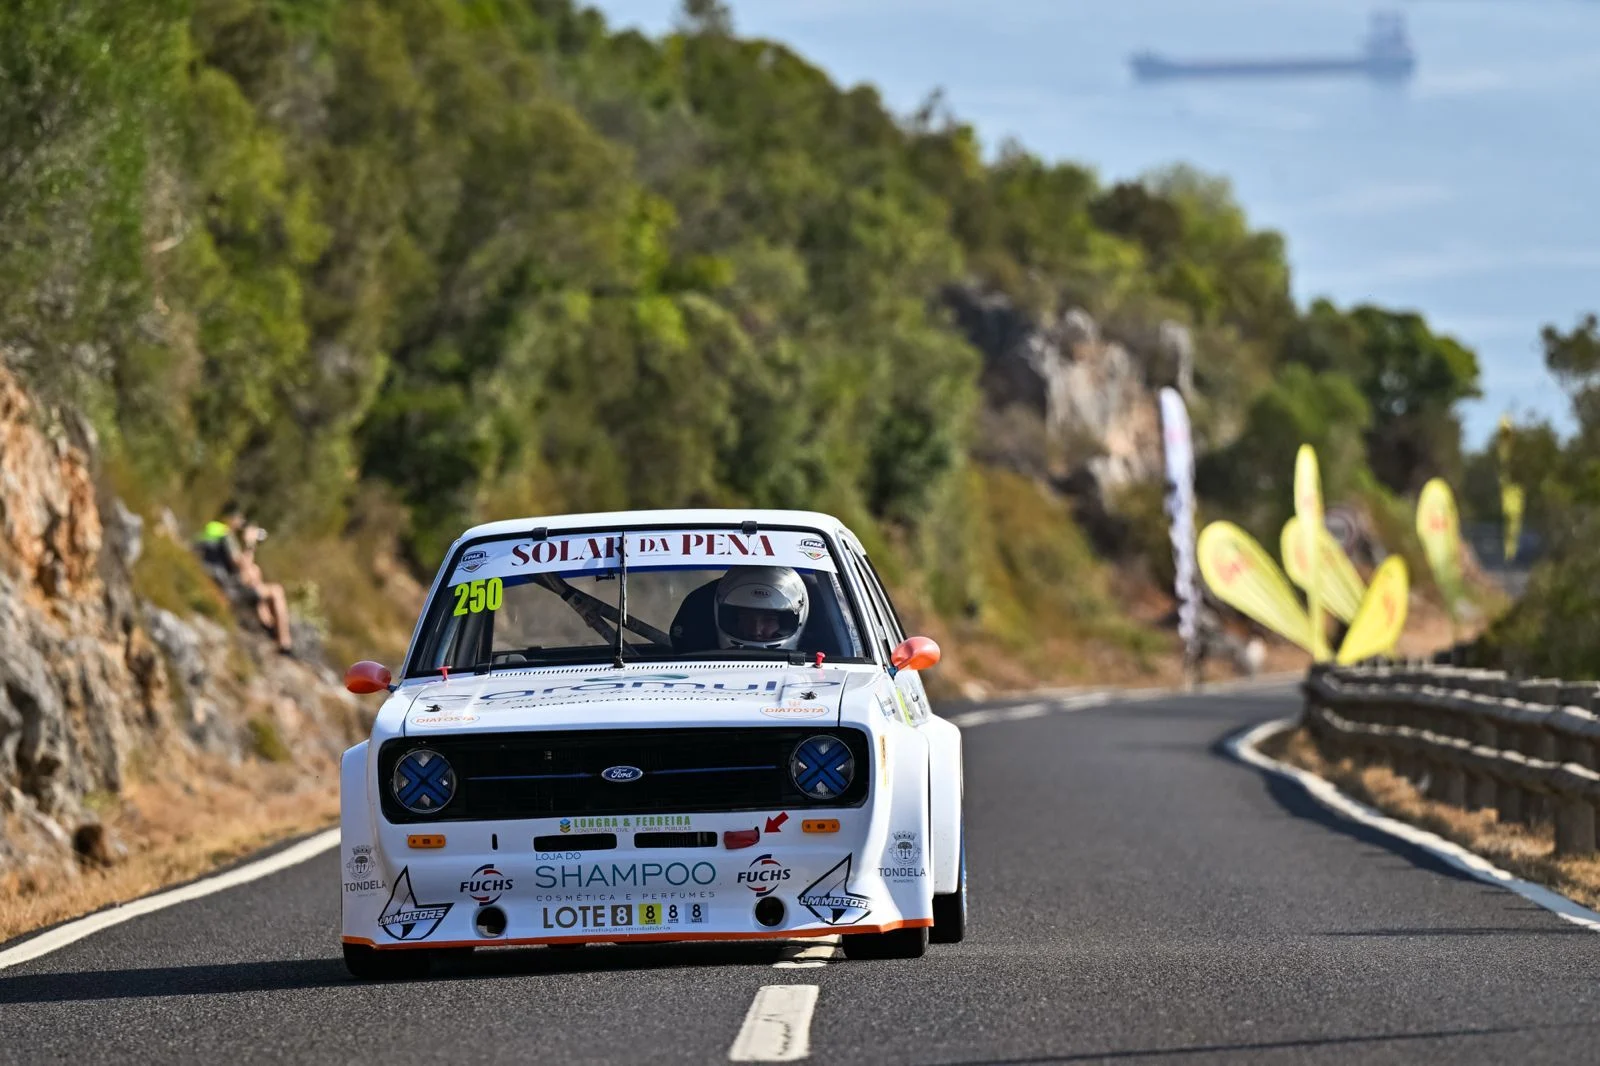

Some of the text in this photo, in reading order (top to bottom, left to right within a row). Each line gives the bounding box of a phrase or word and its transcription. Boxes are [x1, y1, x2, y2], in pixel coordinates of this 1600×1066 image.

[511, 533, 776, 567] SOLAR DA PENA
[453, 577, 503, 617] 250
[611, 768, 633, 779] Ford
[574, 815, 692, 828] LONGRA & FERREIRA
[535, 851, 582, 861] LOJA DO
[535, 861, 717, 889] SHAMPOO
[737, 868, 791, 884] FUCHS
[878, 867, 926, 878] TONDELA
[344, 880, 387, 893] TONDELA
[459, 878, 514, 893] FUCHS
[536, 893, 616, 902] COSMÉTICA
[643, 891, 716, 900] PERFUMES
[543, 905, 628, 929] LOTE 8
[645, 904, 656, 920] 8
[668, 904, 679, 919] 8
[692, 903, 702, 918] 8
